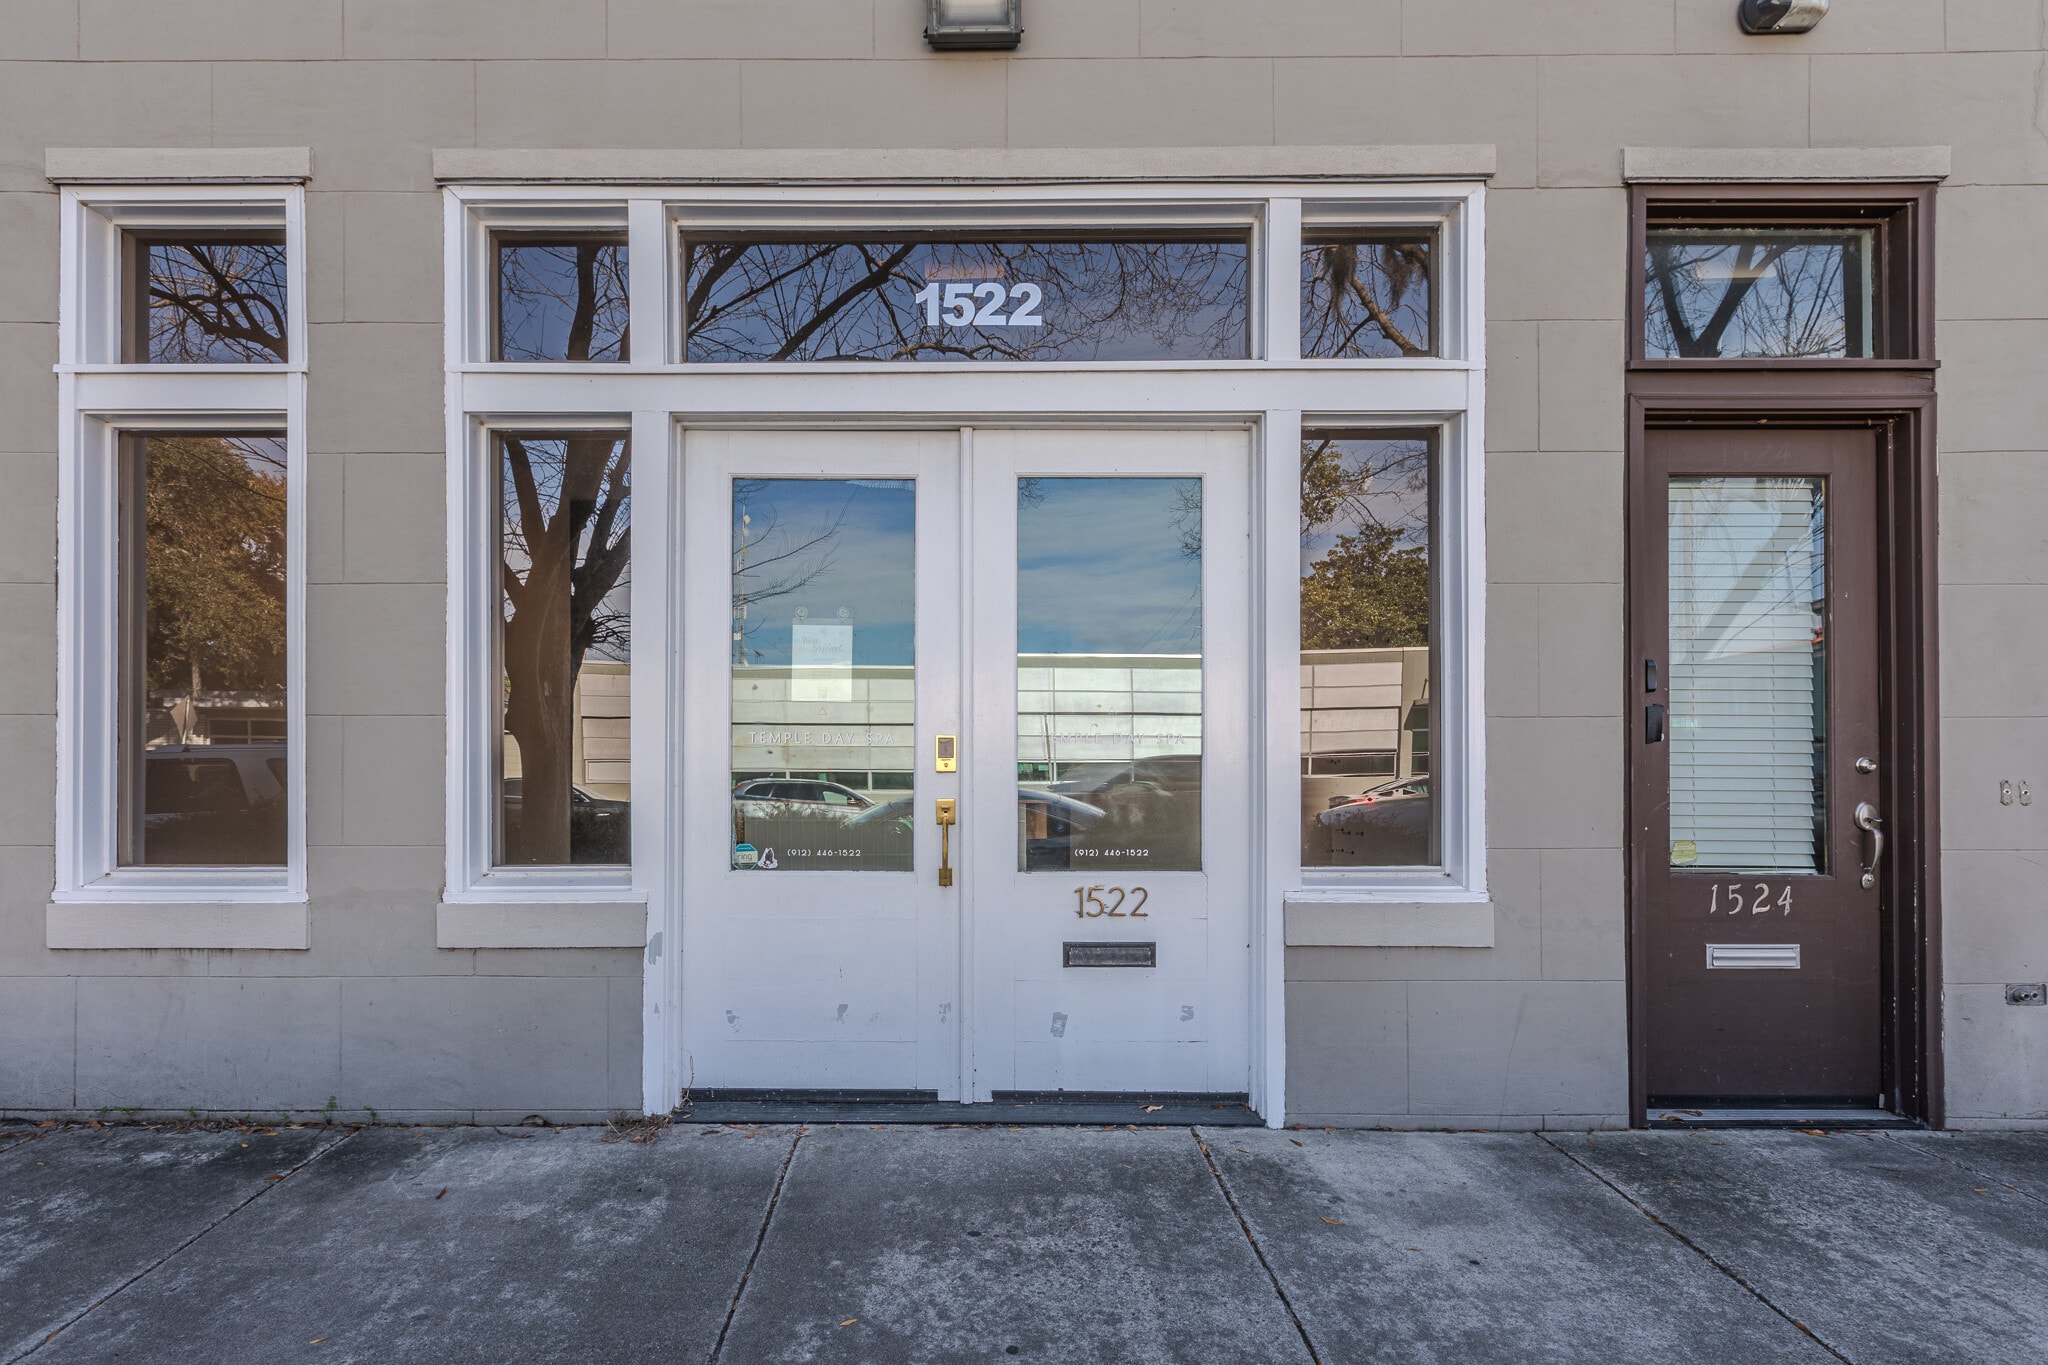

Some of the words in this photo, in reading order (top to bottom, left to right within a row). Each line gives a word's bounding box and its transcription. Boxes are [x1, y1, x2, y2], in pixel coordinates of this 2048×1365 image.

[915, 282, 1043, 327] 1522
[748, 731, 812, 745] TEMPLE
[822, 733, 856, 745] DAY
[865, 733, 895, 745] SPA
[1040, 732, 1103, 745] TEMPLE
[1112, 733, 1146, 745] DAY
[1156, 733, 1186, 745] SPA
[737, 853, 753, 862] ring
[786, 849, 812, 857] (912)
[816, 849, 862, 857] 446-1522
[1074, 849, 1100, 857] (912)
[1104, 849, 1149, 857] 446-1522
[1074, 886, 1149, 919] 1522
[1710, 883, 1793, 917] 1524
